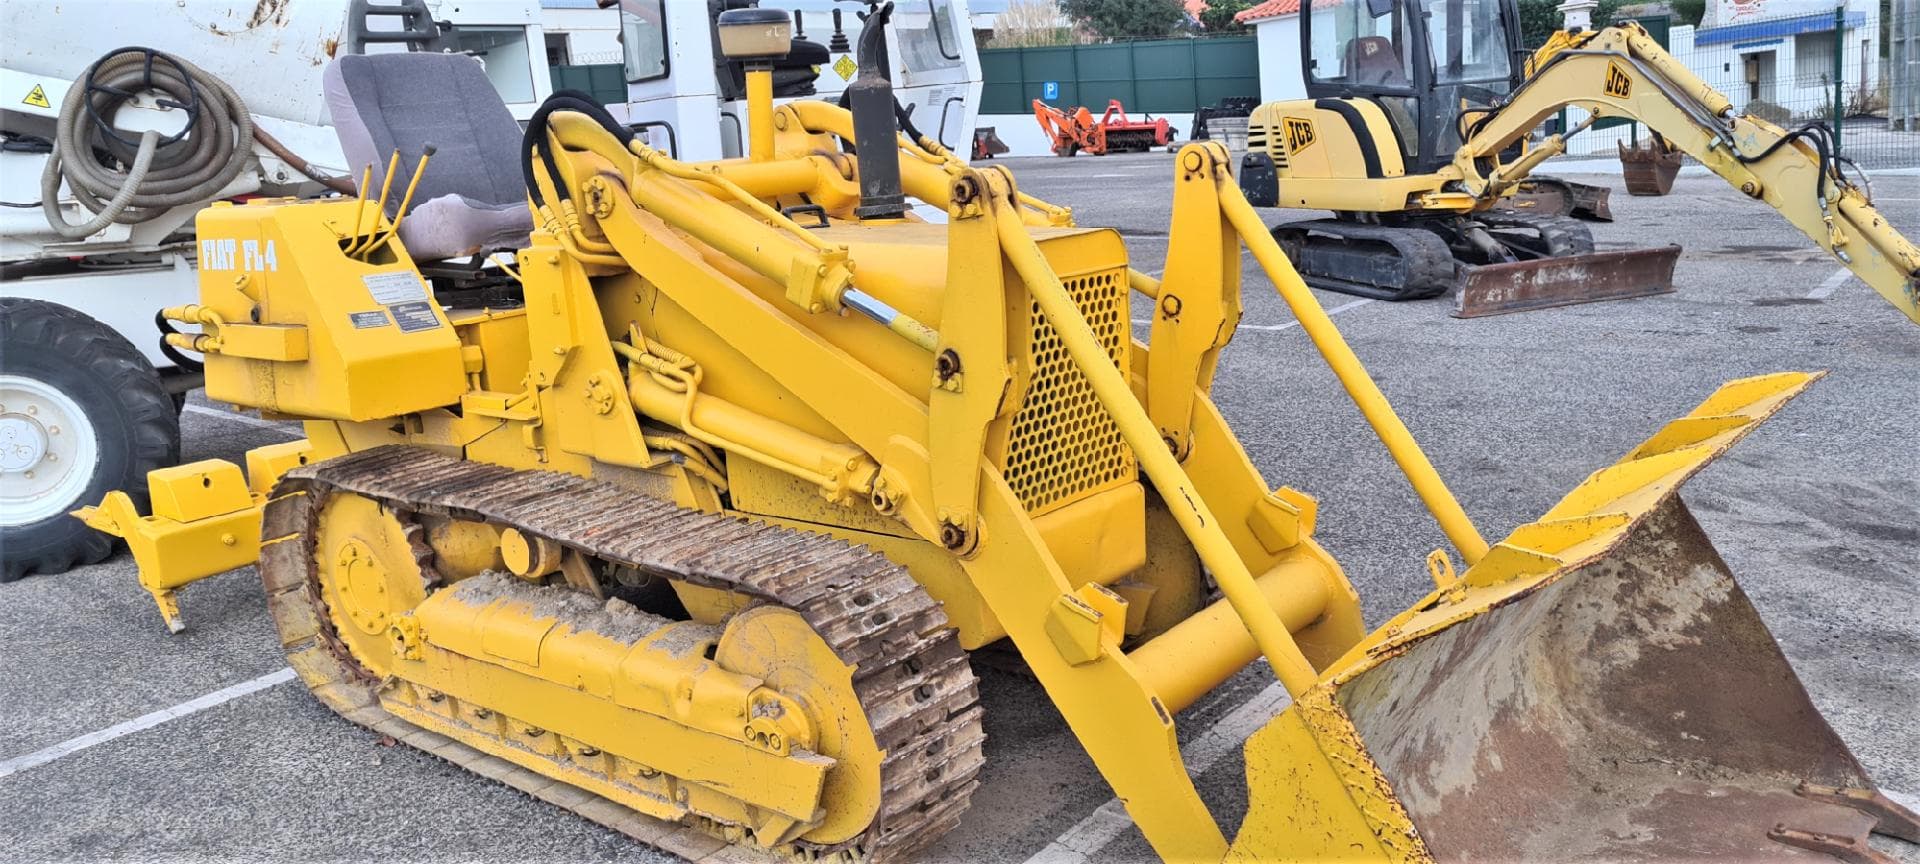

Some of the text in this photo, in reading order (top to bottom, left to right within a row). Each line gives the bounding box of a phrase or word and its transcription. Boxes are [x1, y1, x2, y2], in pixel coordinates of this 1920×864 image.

[1606, 65, 1630, 96] JCB
[1288, 121, 1313, 152] JCB
[201, 239, 277, 272] FIAT FL4
